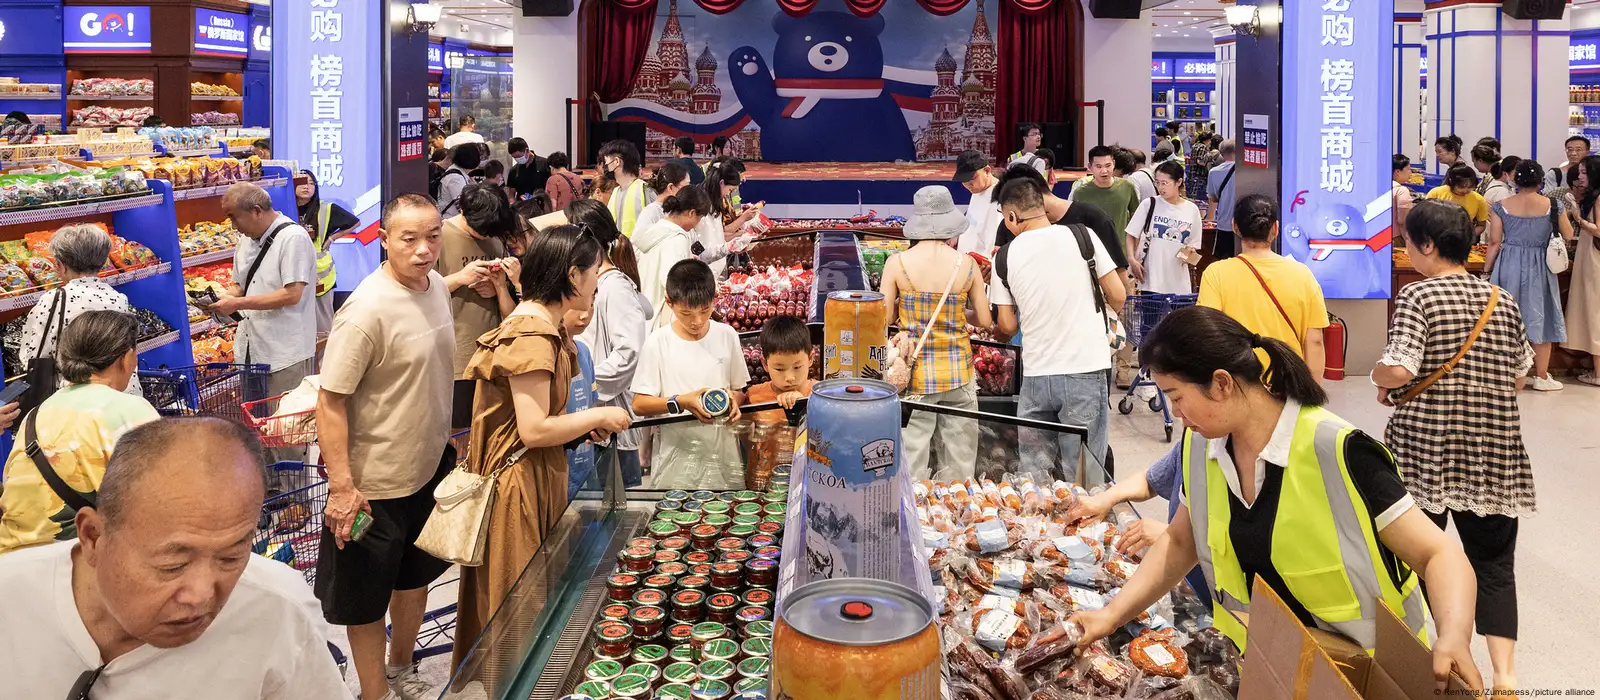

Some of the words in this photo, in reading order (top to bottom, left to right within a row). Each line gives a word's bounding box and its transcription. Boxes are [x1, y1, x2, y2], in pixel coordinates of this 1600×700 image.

[310, 0, 344, 42] 购
[310, 54, 344, 187] 榜首商城
[1320, 58, 1355, 193] 榜首商城
